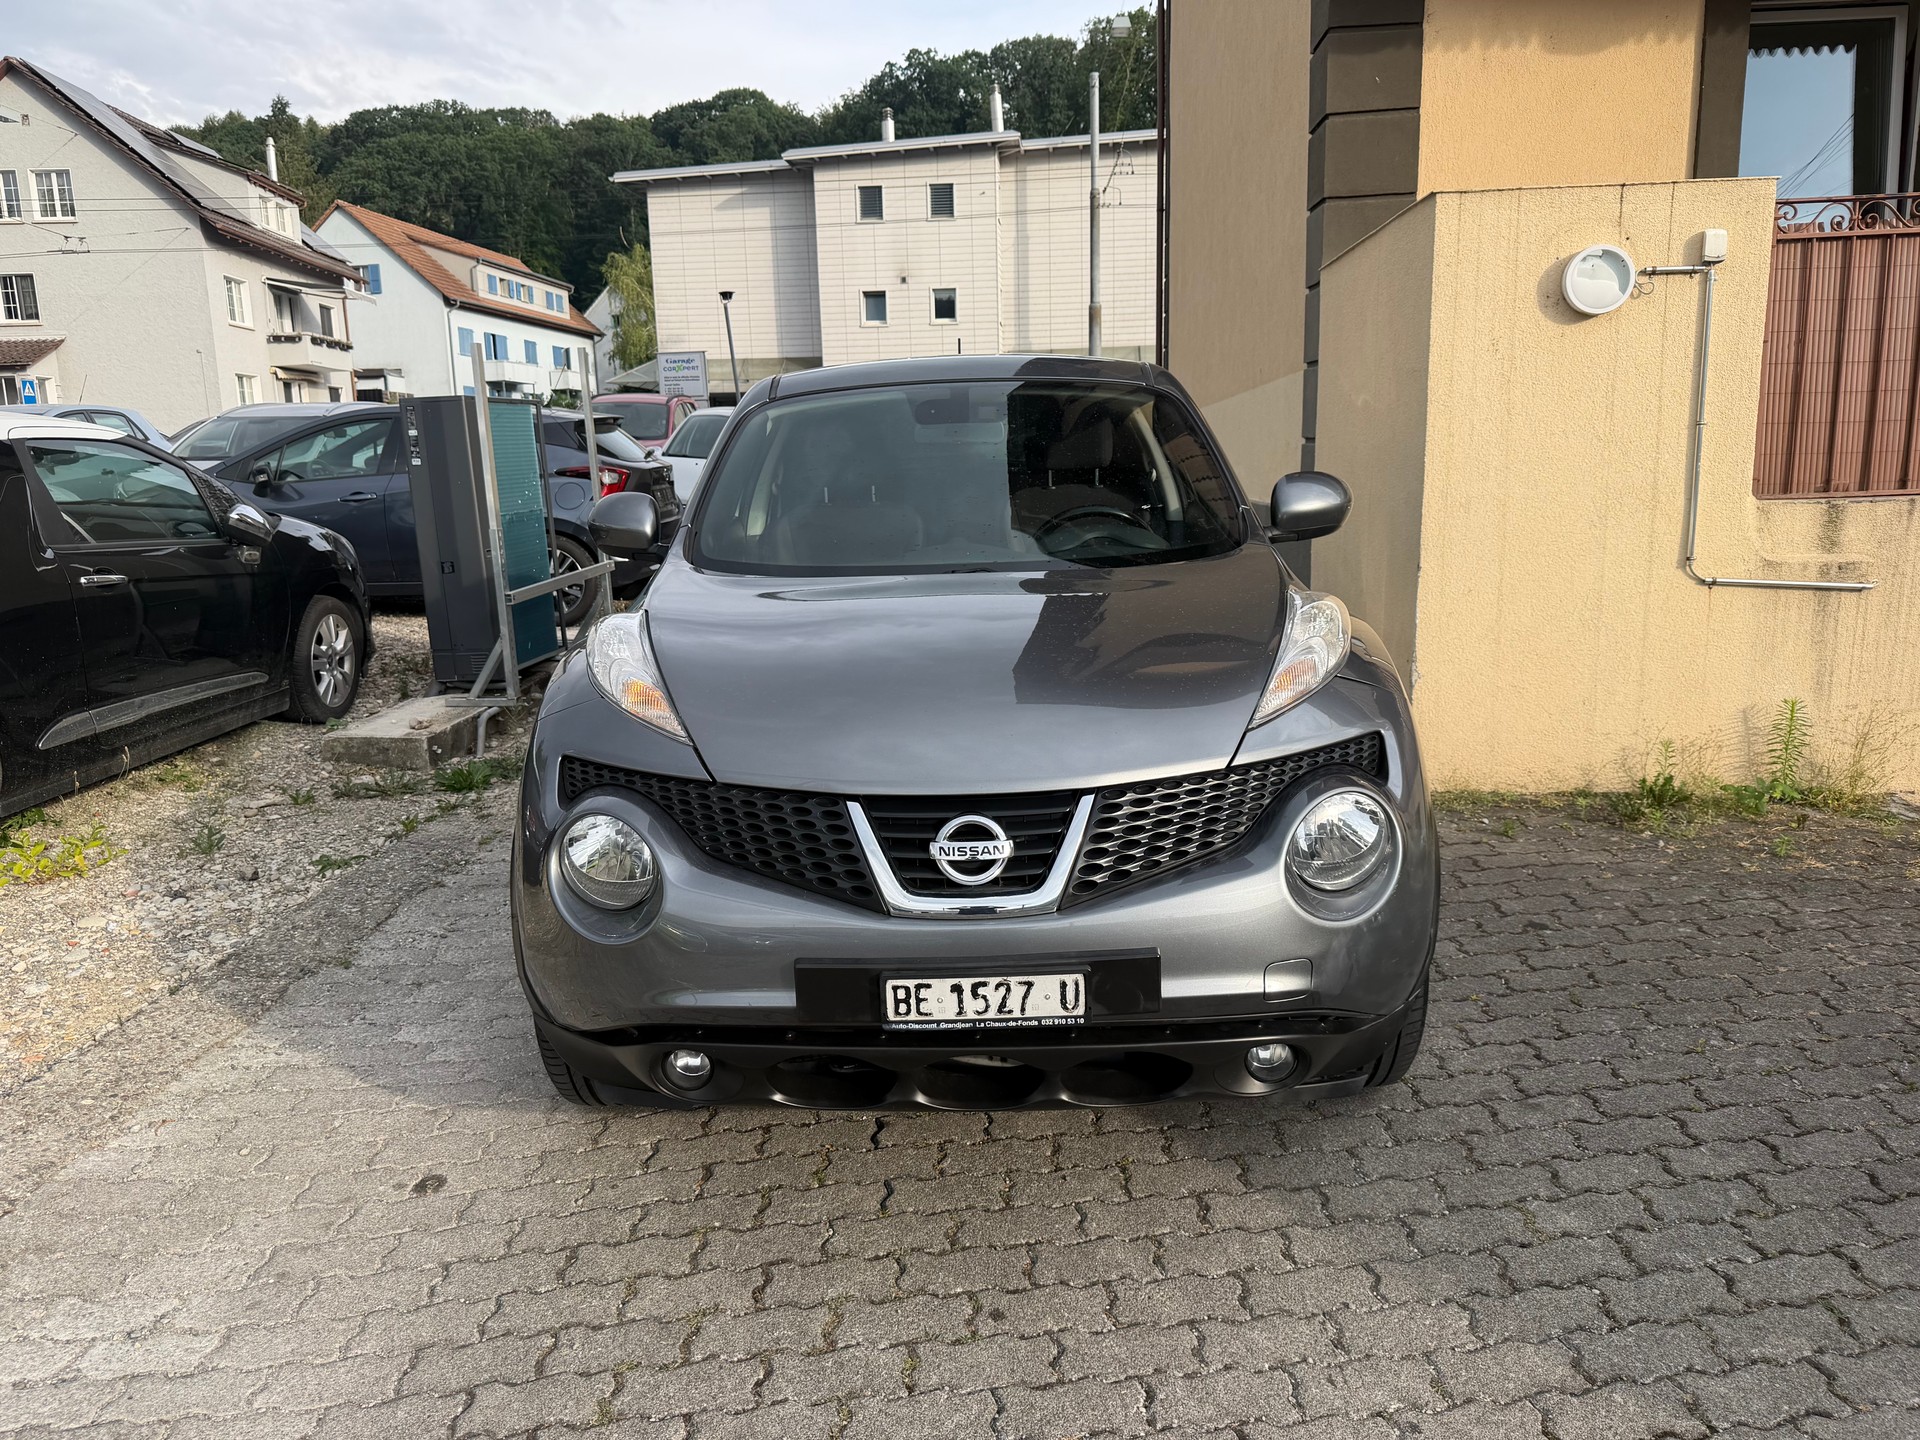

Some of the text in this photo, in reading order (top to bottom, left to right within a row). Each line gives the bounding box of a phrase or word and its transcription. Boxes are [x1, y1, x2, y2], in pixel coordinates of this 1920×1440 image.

[938, 845, 1005, 857] NISSAN
[892, 977, 1081, 1018] BE 1527 U
[985, 1020, 1039, 1028] Chaux-de-Fonds
